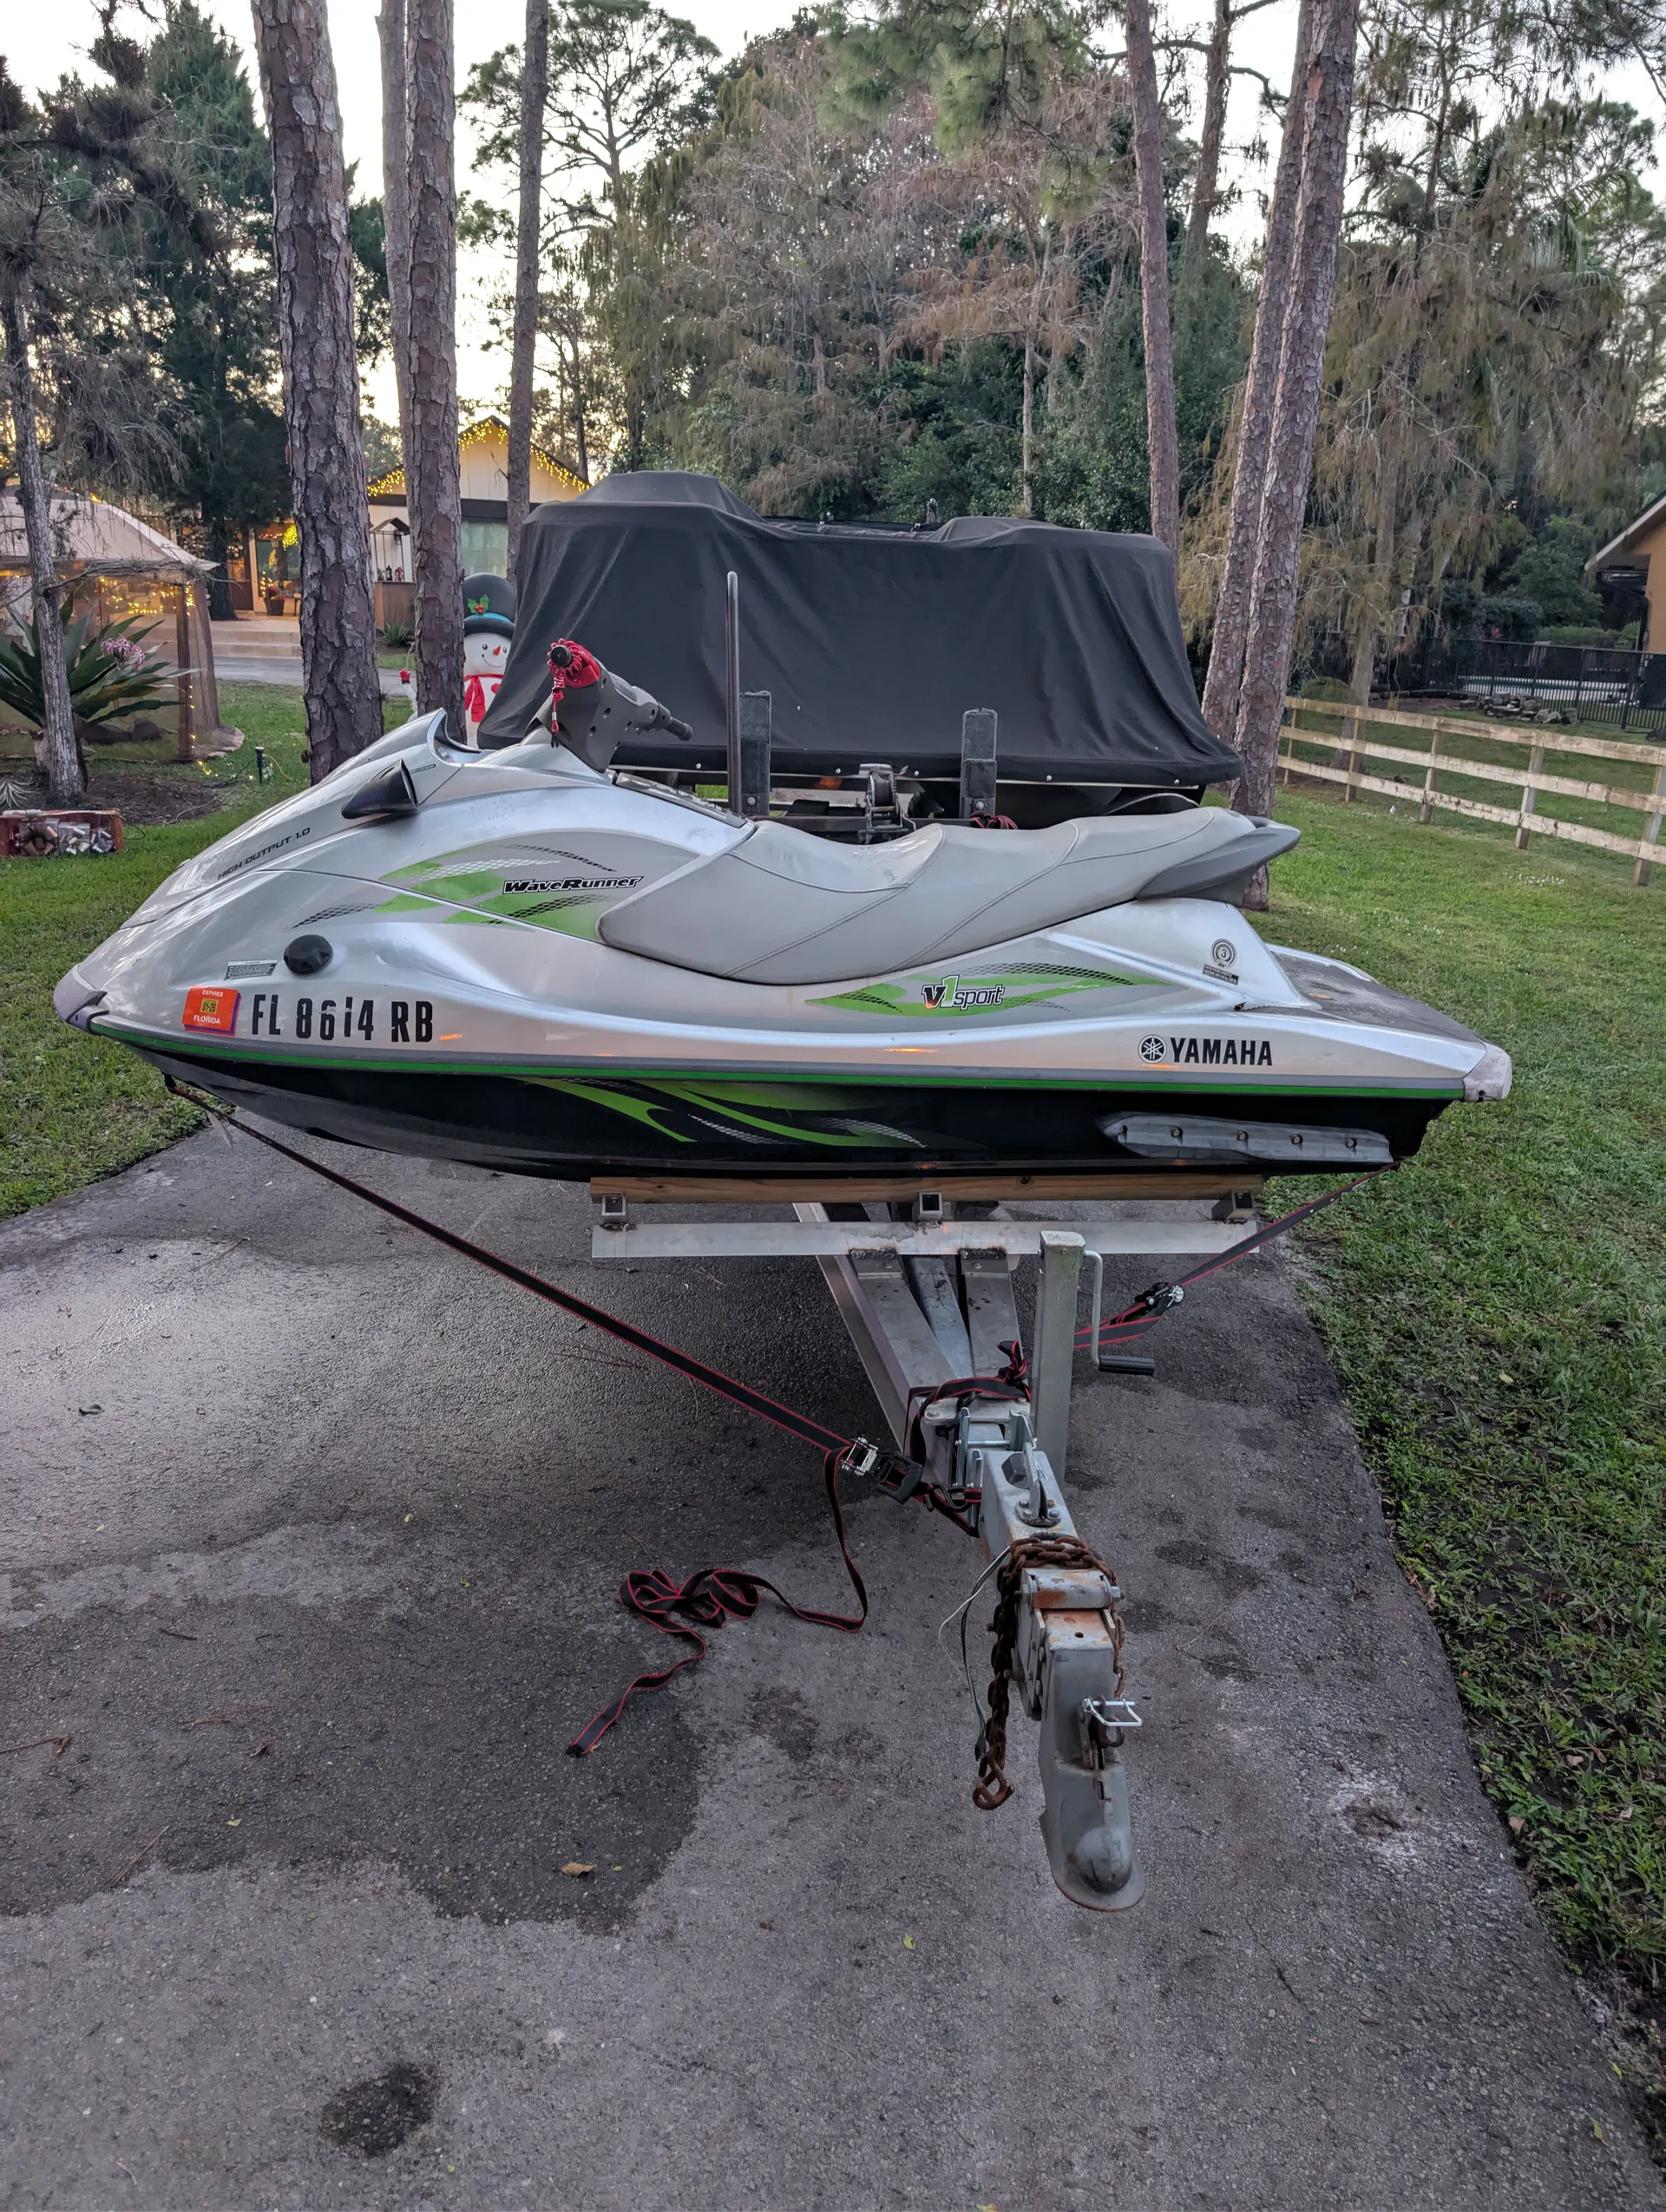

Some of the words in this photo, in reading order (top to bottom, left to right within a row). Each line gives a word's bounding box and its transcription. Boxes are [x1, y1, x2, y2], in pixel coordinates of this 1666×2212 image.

[218, 861, 242, 880] HIGH
[245, 835, 292, 864] OUTPUT
[295, 827, 311, 839] 1.0
[502, 875, 644, 894] WaveRunner
[1220, 948, 1227, 959] 3
[201, 989, 224, 998] EXPIRES
[202, 1001, 217, 1013] 01-26
[193, 1014, 220, 1024] FLORIDA
[252, 993, 281, 1036] FL
[391, 1001, 434, 1043] RB
[1170, 1037, 1273, 1066] YAMAHA
